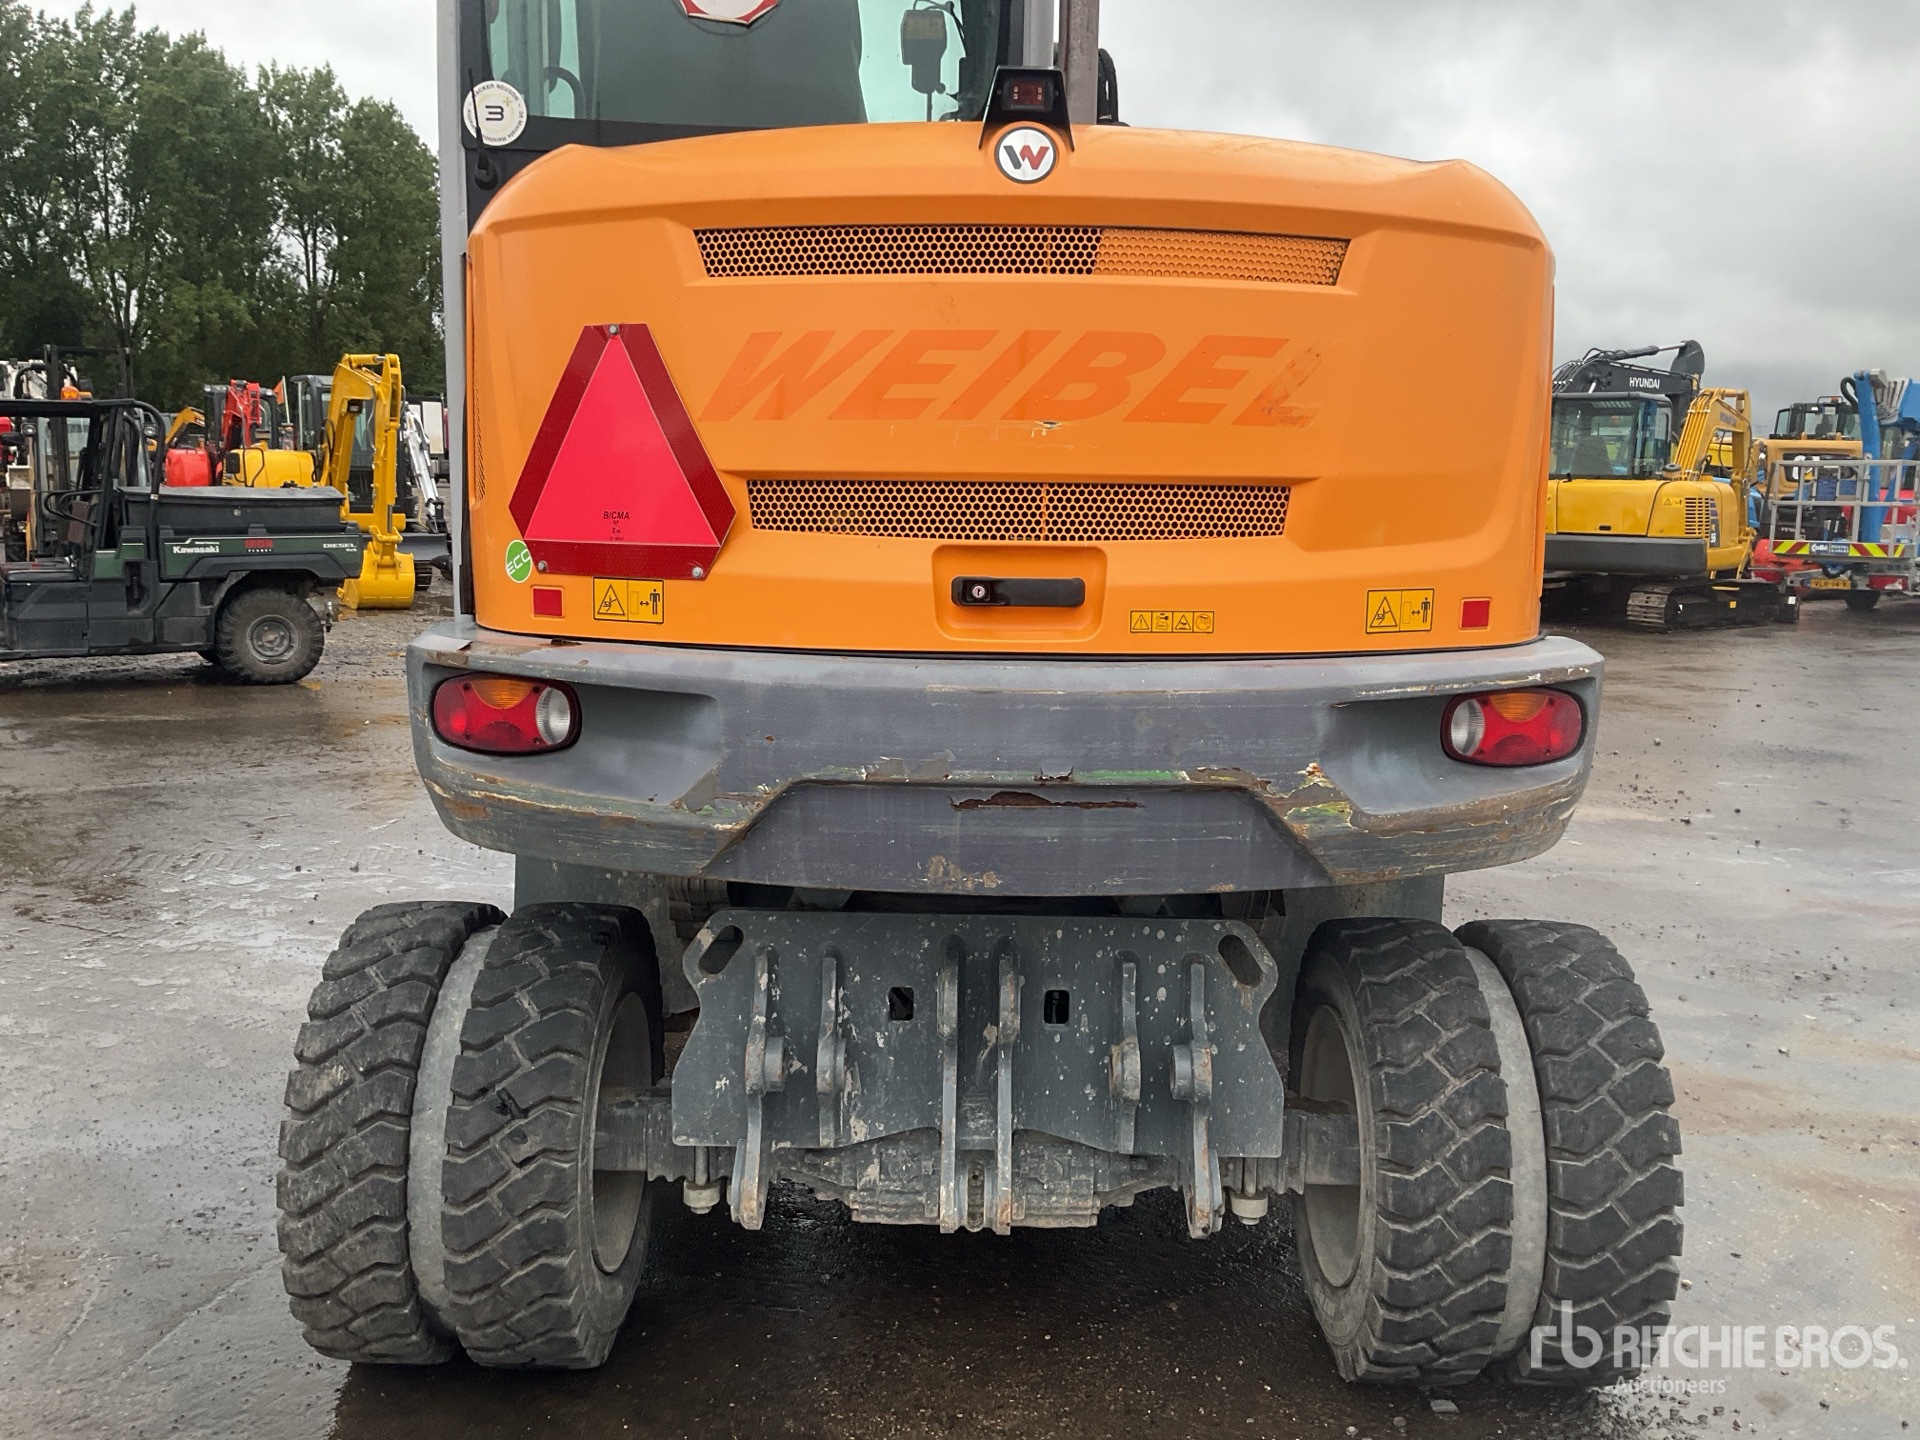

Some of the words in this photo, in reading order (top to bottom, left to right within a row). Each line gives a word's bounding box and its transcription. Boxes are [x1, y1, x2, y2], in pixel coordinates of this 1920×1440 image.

[698, 329, 1322, 428] WEIBEL
[1629, 377, 1660, 389] HYUNDAI
[603, 510, 630, 520] BICMA
[173, 545, 219, 554] Kawasaki
[507, 548, 531, 575] ECO
